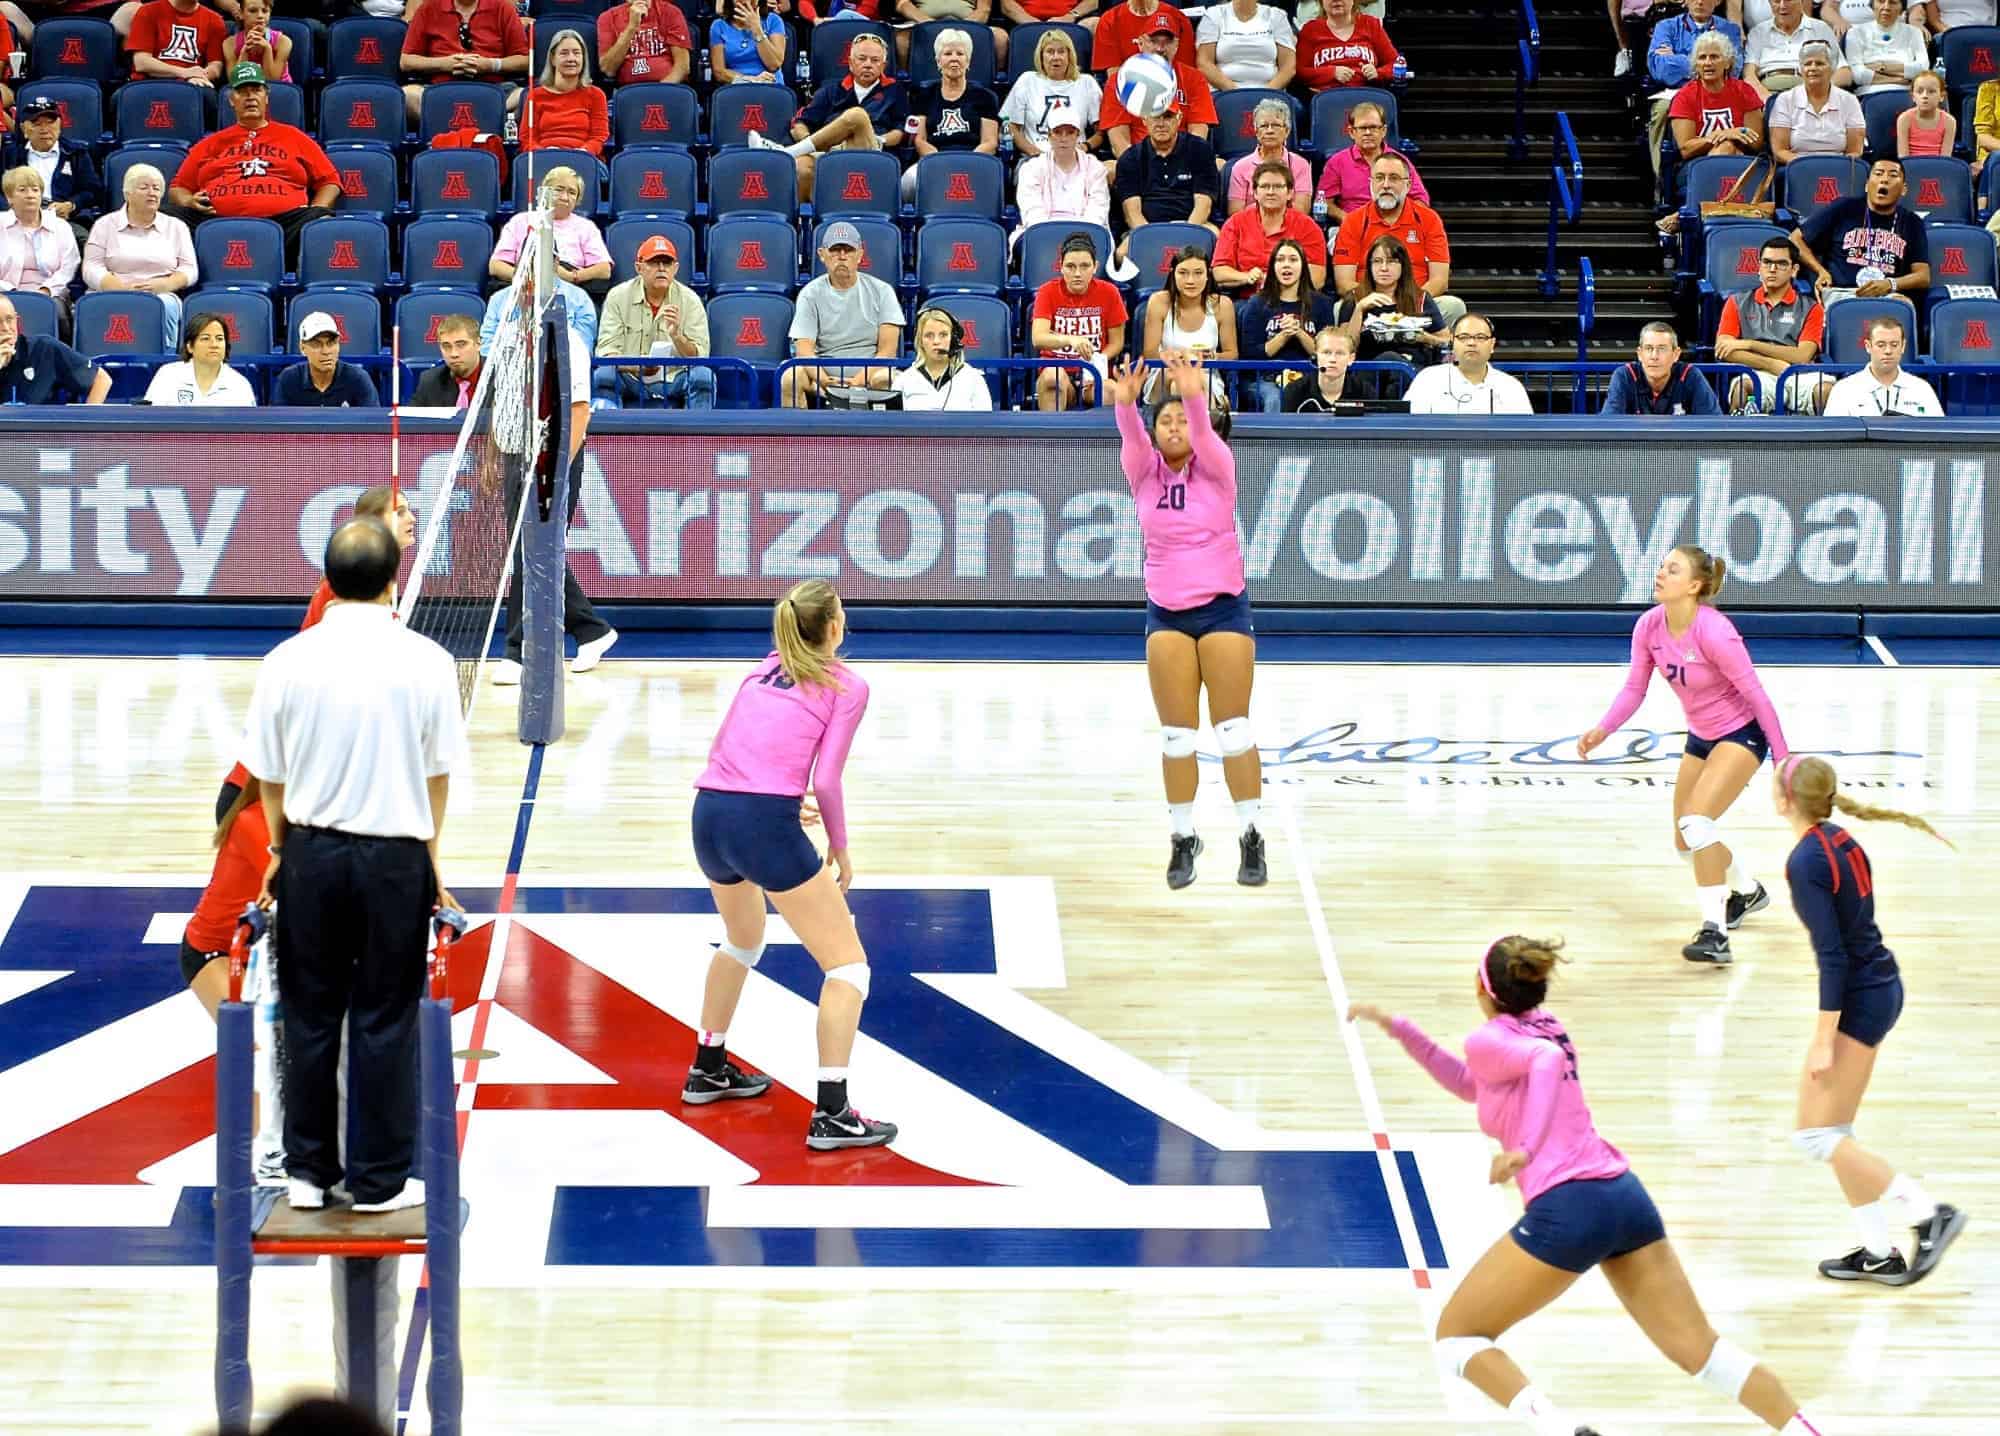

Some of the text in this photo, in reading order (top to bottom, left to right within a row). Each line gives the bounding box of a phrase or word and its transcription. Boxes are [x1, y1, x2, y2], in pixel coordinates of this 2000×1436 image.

[159, 24, 199, 63] A
[937, 108, 970, 134] A
[1156, 483, 1185, 510] 20
[564, 451, 1145, 580] Arizona
